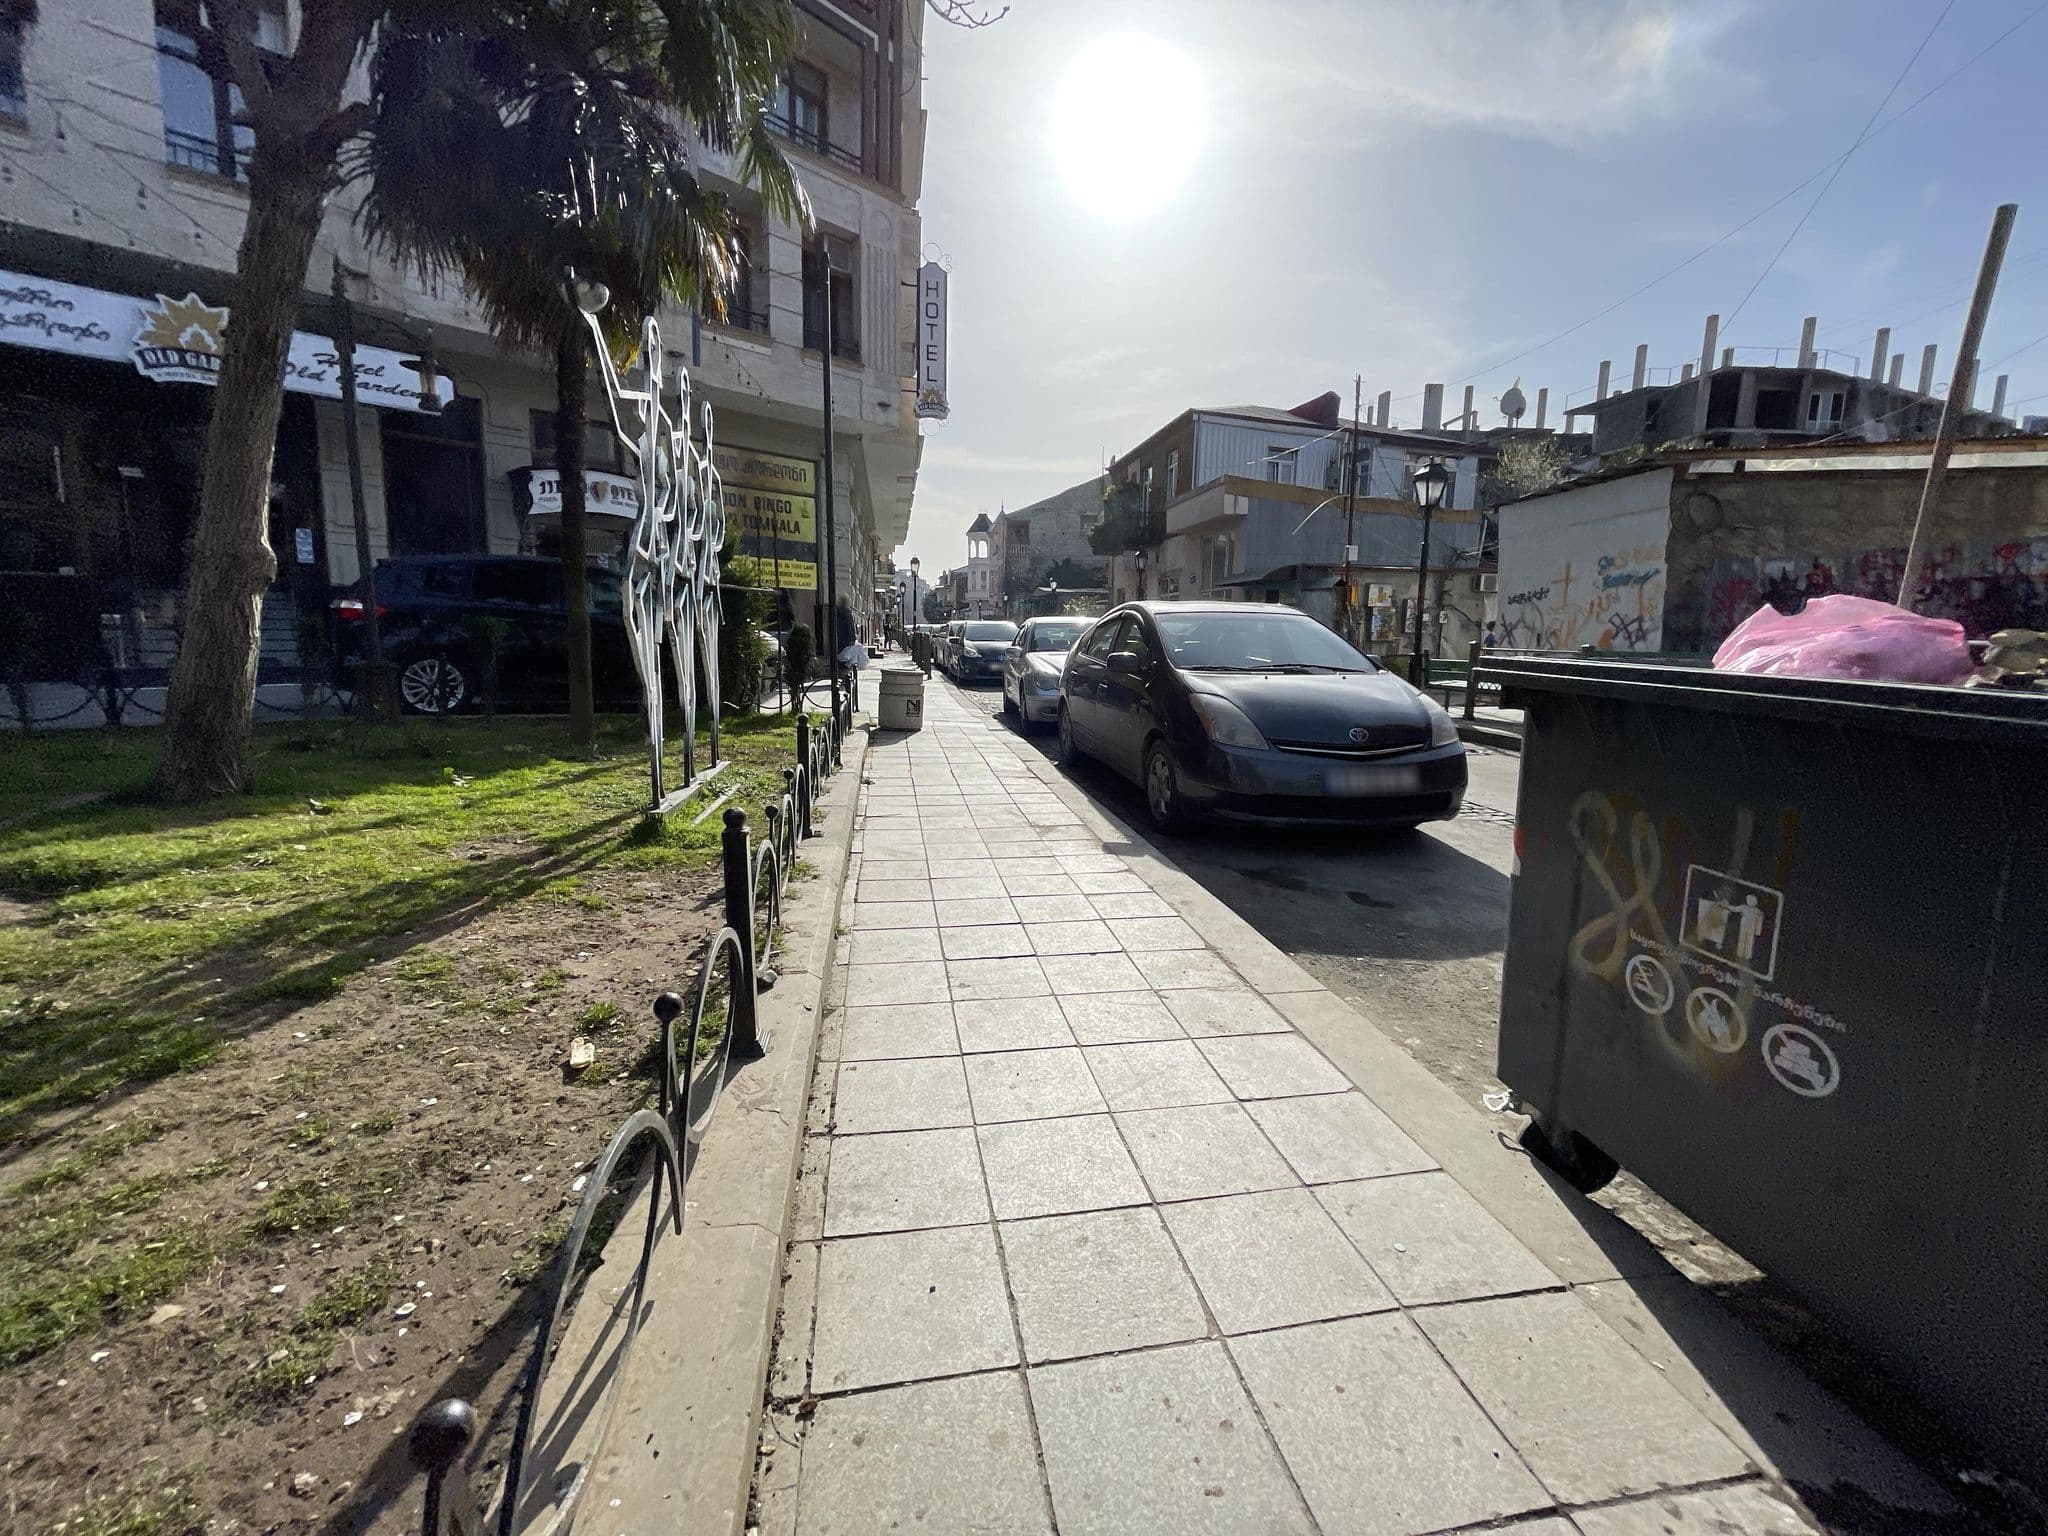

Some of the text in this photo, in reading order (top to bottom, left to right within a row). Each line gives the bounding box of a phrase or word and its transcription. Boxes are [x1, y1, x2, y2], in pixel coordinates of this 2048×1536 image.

[925, 280, 939, 383] HOTEL
[144, 350, 220, 371] OLD GAR
[312, 352, 385, 377] Htel
[336, 372, 424, 399] arden
